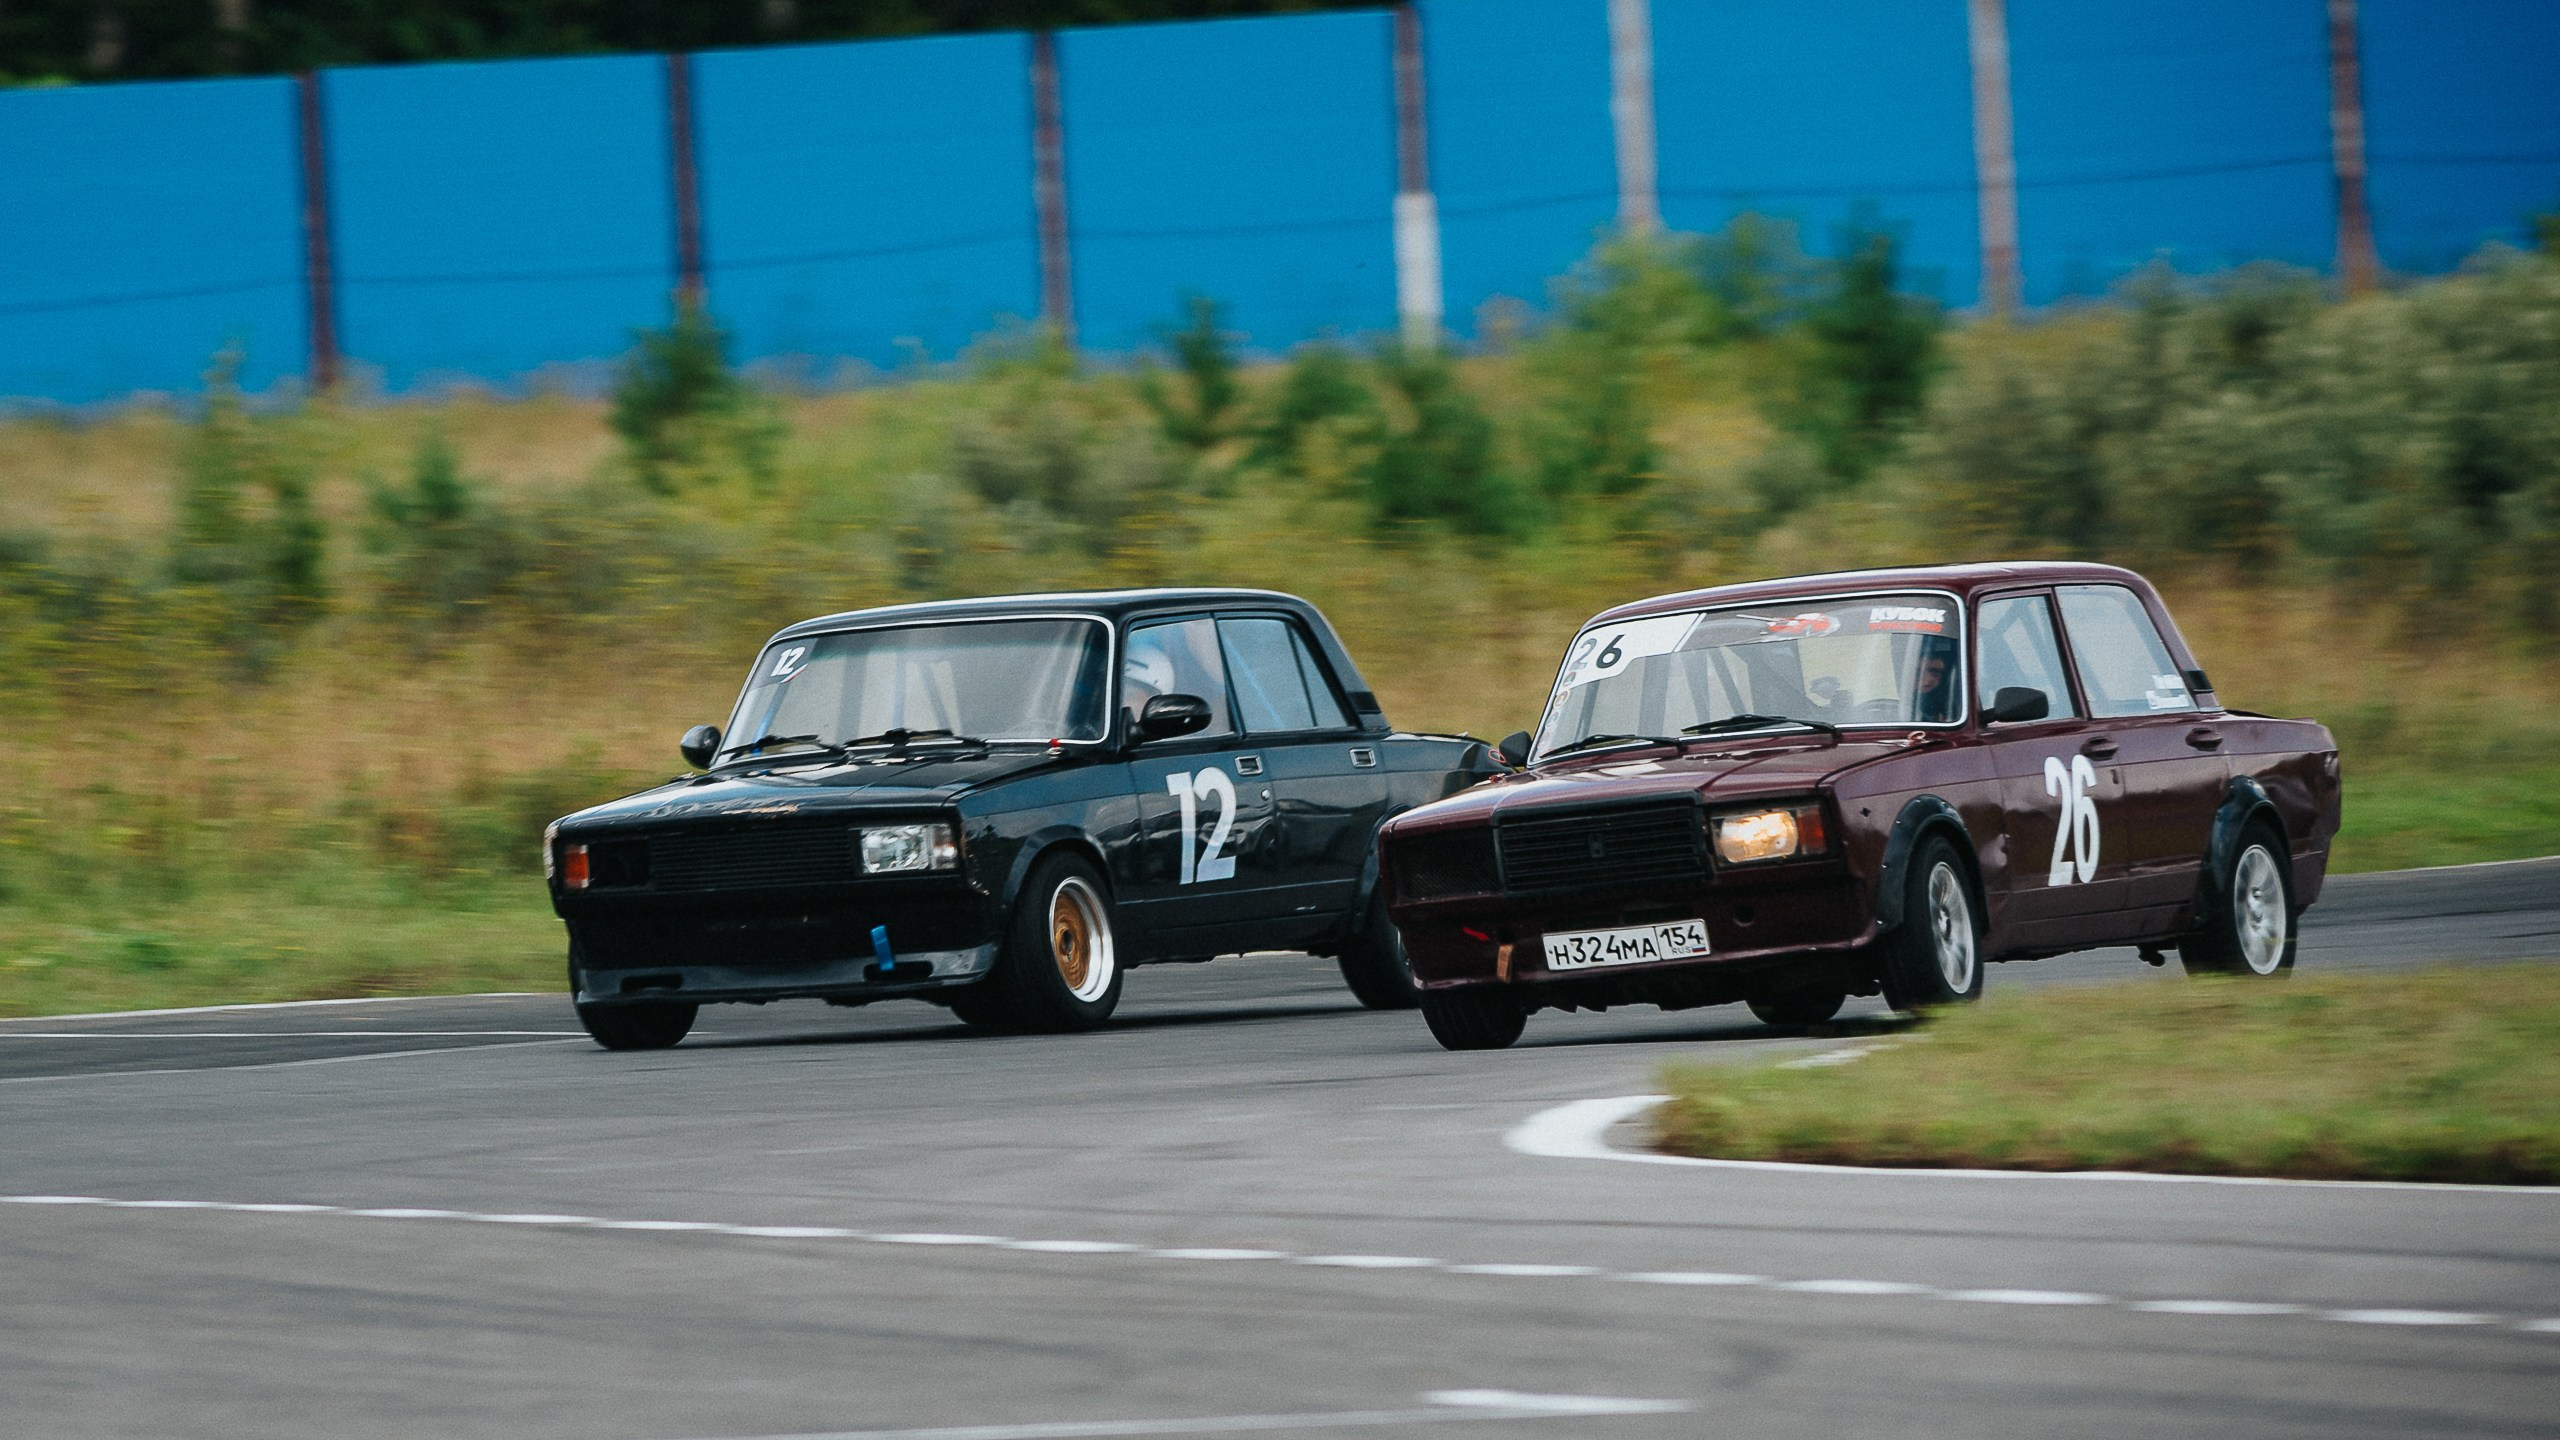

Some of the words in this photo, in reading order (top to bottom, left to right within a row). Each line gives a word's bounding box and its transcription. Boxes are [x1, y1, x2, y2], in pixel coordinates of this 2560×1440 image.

[1869, 607, 1946, 623] КУБОК
[770, 646, 806, 677] 12
[1568, 634, 1626, 671] 26
[1165, 766, 1237, 885] 12
[2044, 754, 2100, 886] 26
[1553, 935, 1657, 966] Н324МА
[1660, 925, 1704, 947] 154
[1671, 946, 1692, 955] RUS
